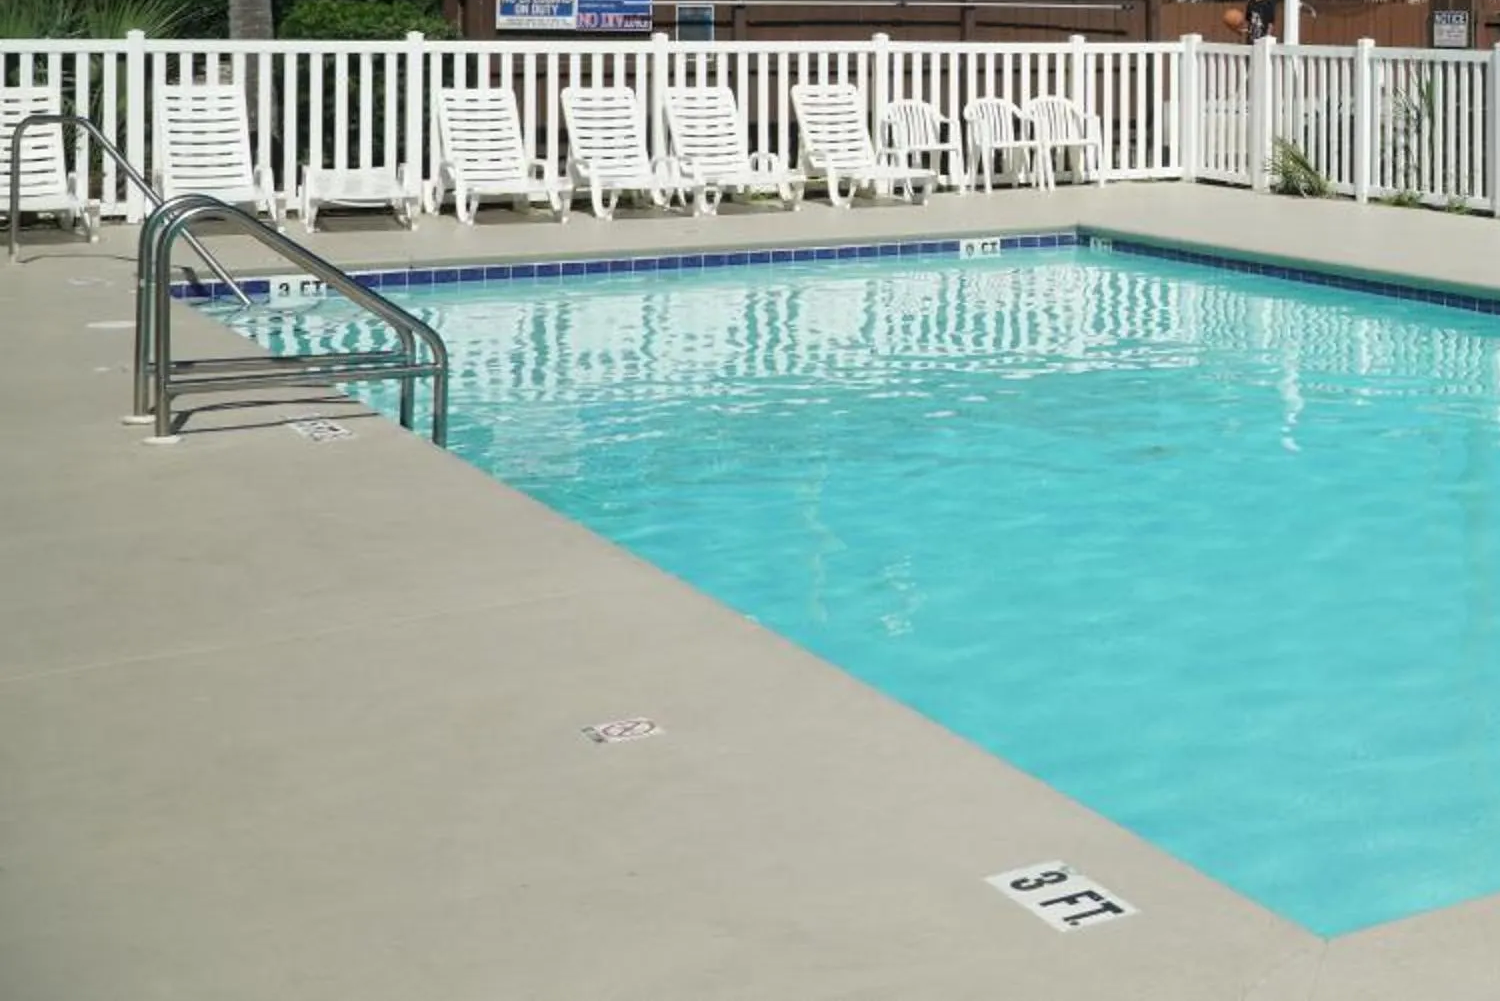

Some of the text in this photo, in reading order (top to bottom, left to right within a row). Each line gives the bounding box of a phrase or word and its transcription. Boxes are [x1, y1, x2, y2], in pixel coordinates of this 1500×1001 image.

[515, 4, 559, 15] ON DUTY
[577, 13, 599, 28] NO
[1010, 870, 1068, 891] 3
